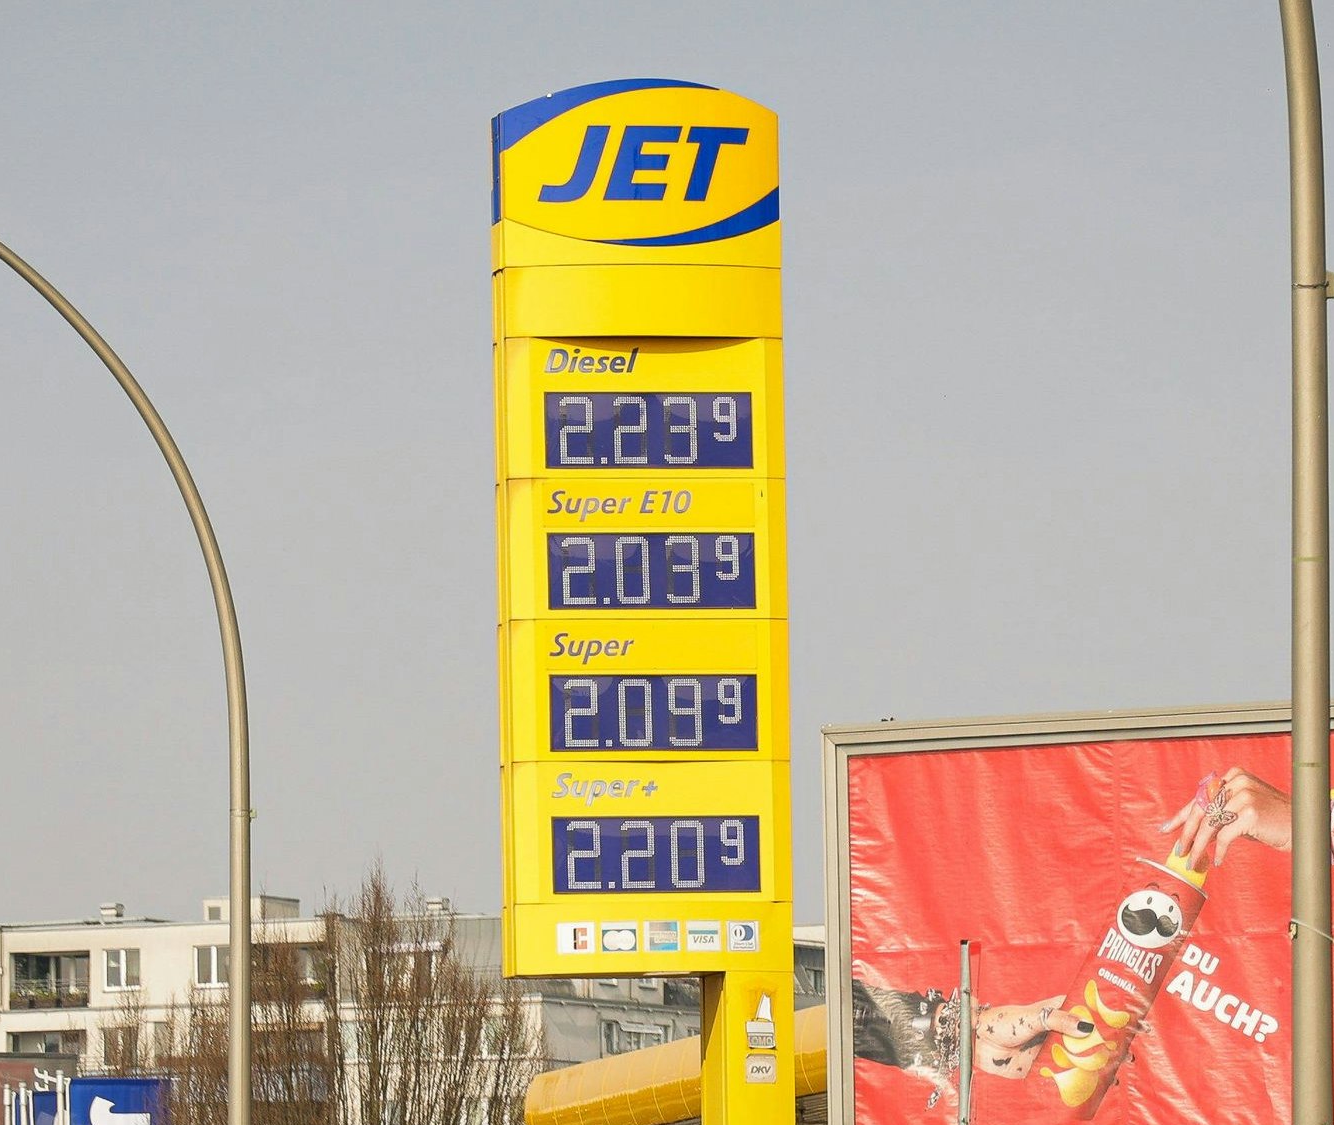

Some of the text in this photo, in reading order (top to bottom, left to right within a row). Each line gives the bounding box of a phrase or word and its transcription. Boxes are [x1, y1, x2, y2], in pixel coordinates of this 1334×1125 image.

[538, 125, 749, 202] JET
[543, 348, 639, 374] Diesel
[547, 490, 692, 522] Super E10
[549, 633, 634, 665] Super
[552, 772, 658, 806] Super+
[692, 935, 715, 944] VISA
[1096, 927, 1163, 985] PRINGLES
[1181, 943, 1220, 976] DU
[1097, 967, 1137, 993] ORIGINAL
[1166, 969, 1279, 1043] AUCH?
[750, 1065, 771, 1074] DKV
